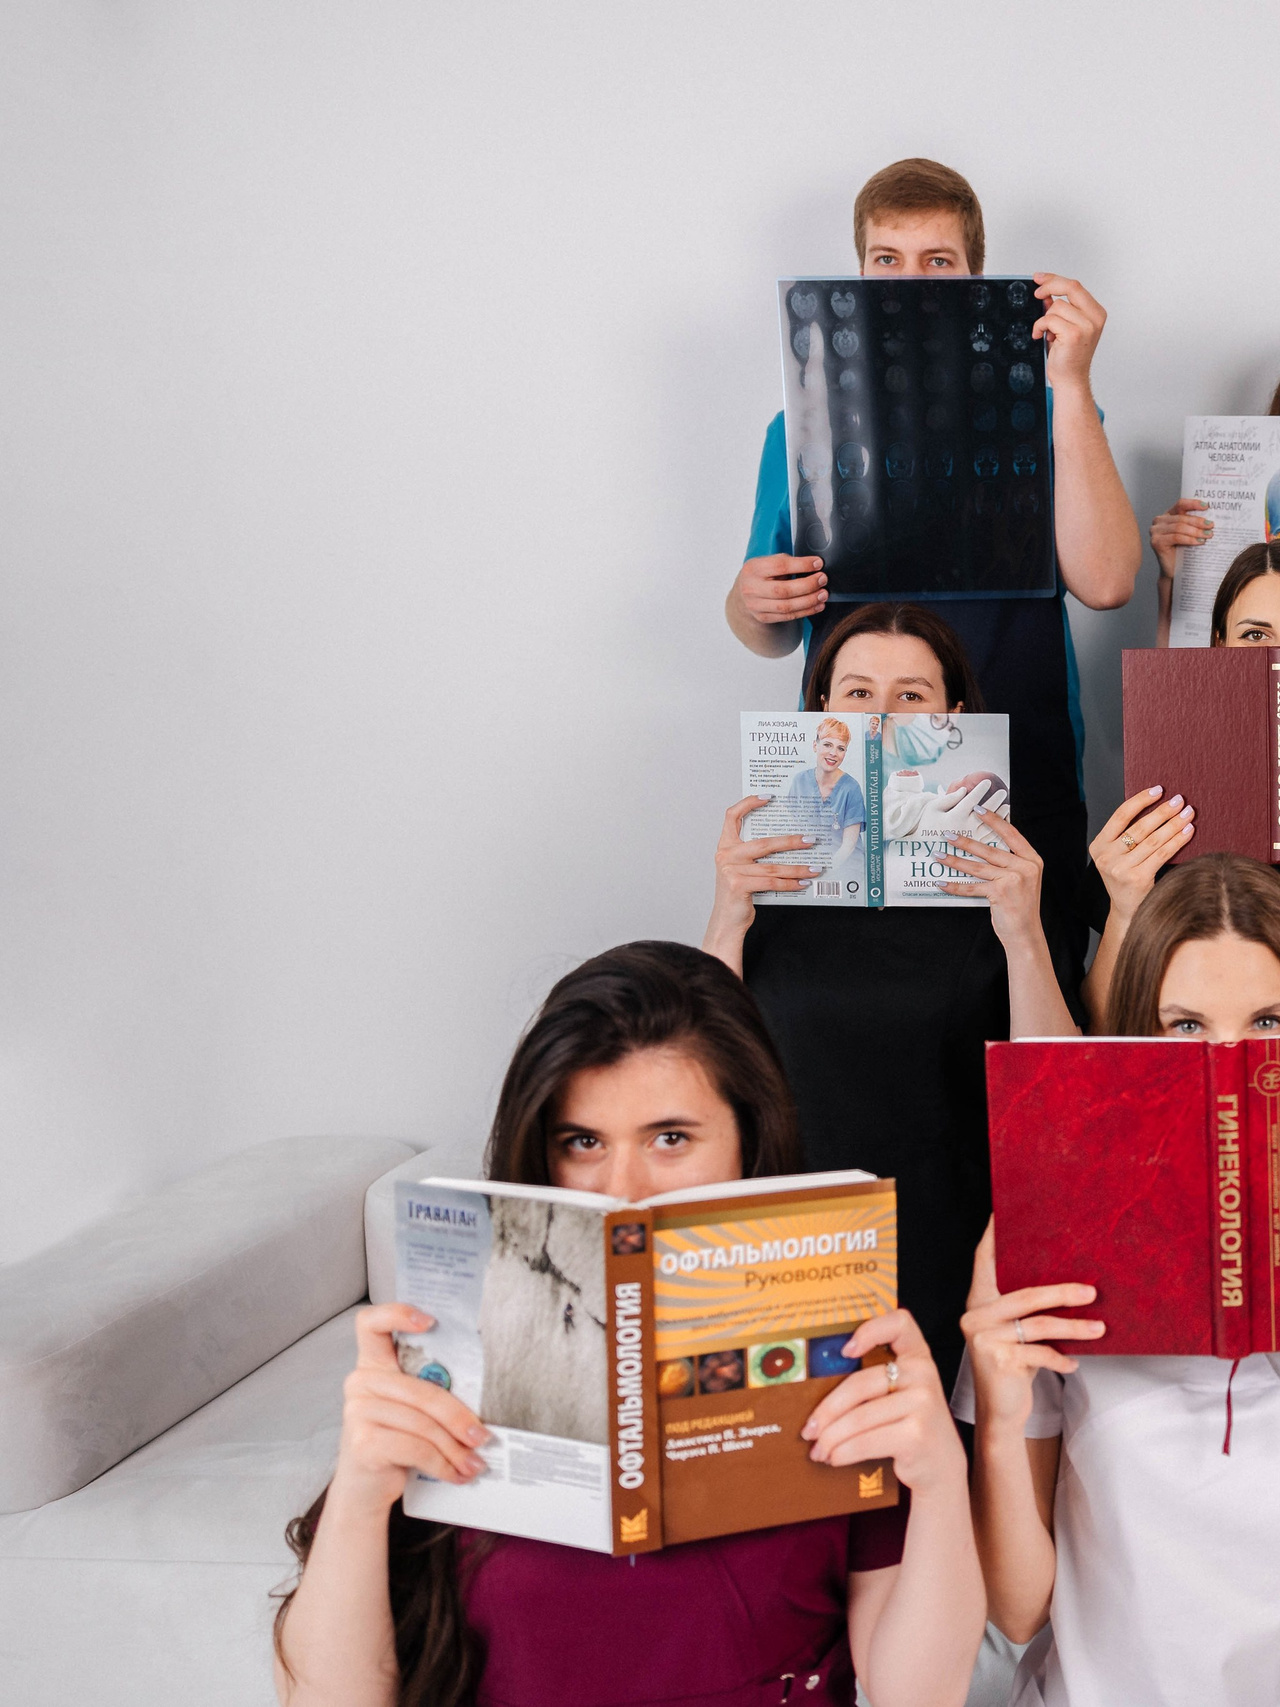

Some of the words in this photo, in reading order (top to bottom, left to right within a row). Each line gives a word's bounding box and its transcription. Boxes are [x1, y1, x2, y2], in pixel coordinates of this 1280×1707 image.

[1194, 441, 1218, 451] АТЛАС
[1218, 442, 1261, 451] АНАТОМИИ
[1208, 453, 1245, 462] ЧЕЛОВЕКА
[1194, 490, 1216, 498] ATLAS
[1217, 490, 1226, 499] OF
[1227, 490, 1256, 500] HUMAN
[749, 732, 806, 743] ТРУДНАЯ
[758, 746, 799, 756] НОША
[869, 770, 878, 816] ТРУДНАЯ
[871, 818, 879, 851] НОША
[940, 830, 973, 838] ХЗАРД
[911, 861, 975, 878] НОШ
[1216, 1094, 1244, 1308] ГИНЕКОЛОГИЯ
[660, 1228, 879, 1275] ОФТАЛЬМОЛОГИЯ
[744, 1260, 879, 1291] Руководство
[615, 1282, 645, 1491] ОФТАЛЬМОЛОГИЯ
